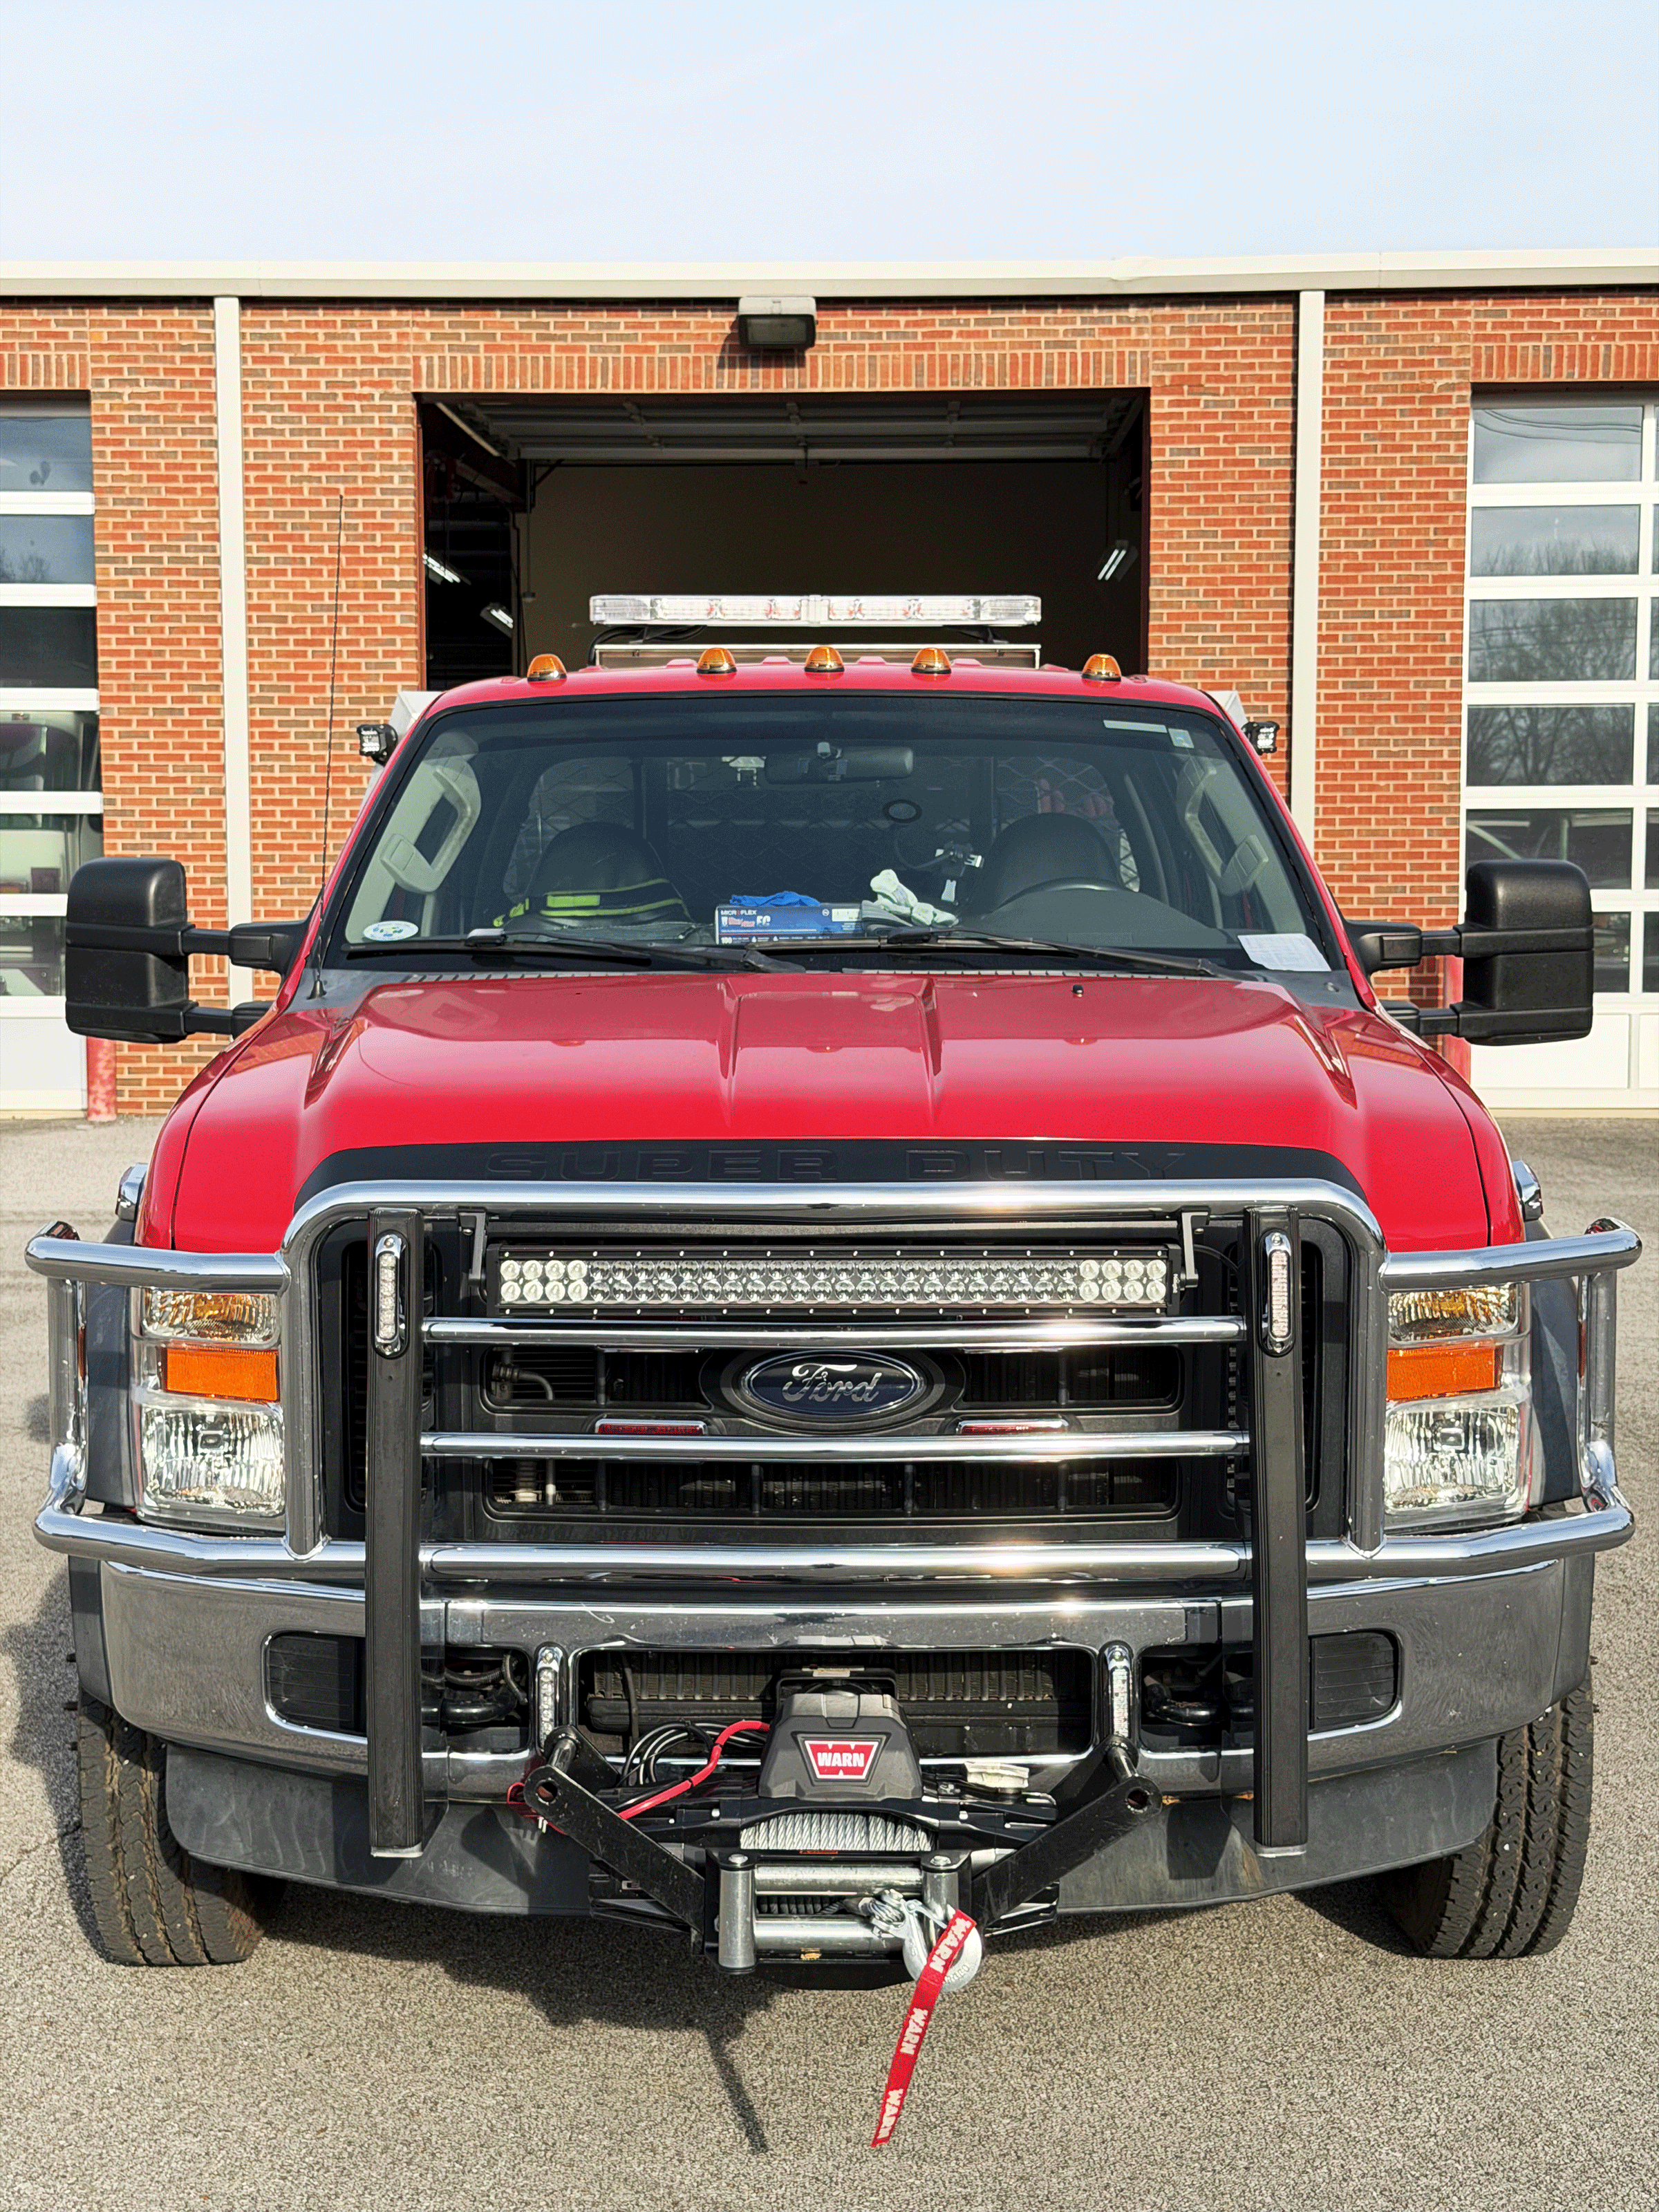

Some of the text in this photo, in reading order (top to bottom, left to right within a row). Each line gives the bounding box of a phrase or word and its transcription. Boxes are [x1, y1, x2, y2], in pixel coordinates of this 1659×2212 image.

[486, 1149, 1187, 1181] SUPER DUTY
[782, 1362, 882, 1403] Ford
[816, 1752, 865, 1768] WARN
[929, 1918, 972, 1974] WARN
[900, 2007, 929, 2055] WARN
[877, 2088, 904, 2139] WARN
